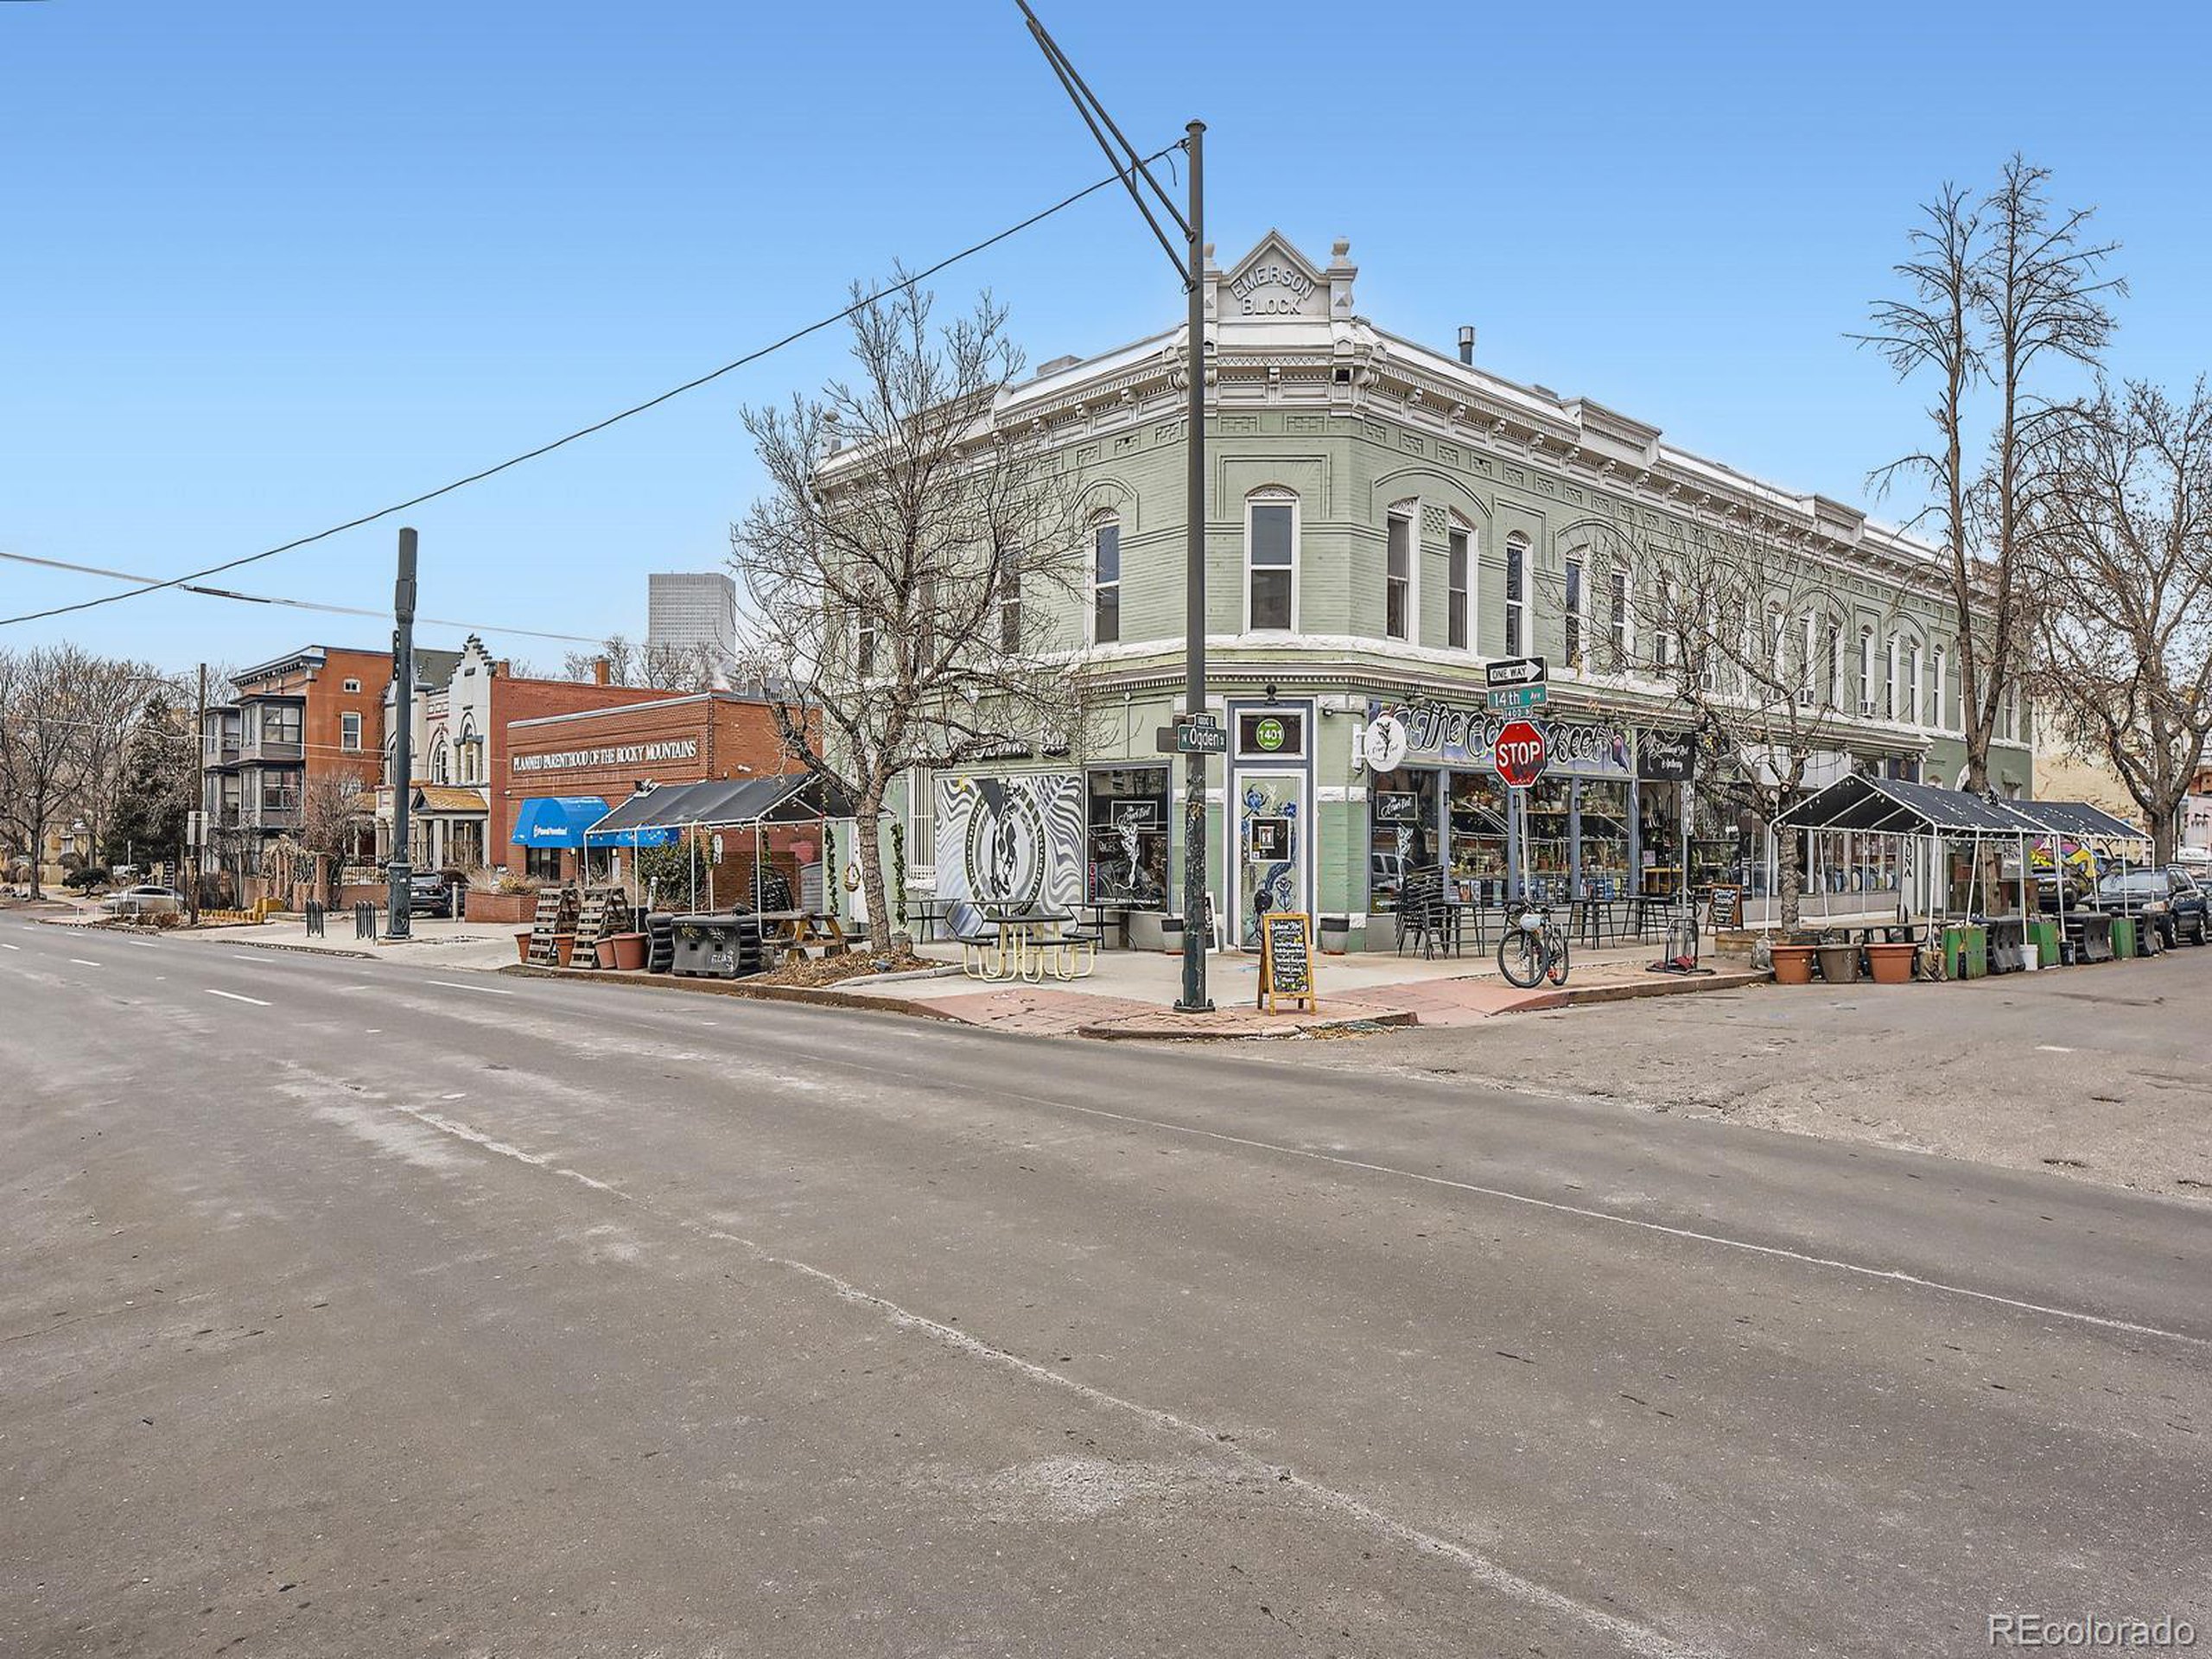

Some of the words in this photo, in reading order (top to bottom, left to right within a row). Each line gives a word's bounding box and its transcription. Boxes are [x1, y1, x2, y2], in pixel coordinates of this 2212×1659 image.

[1229, 265, 1316, 301] EMERSON
[1242, 297, 1301, 315] BLOCK
[1492, 670, 1509, 680] ONE
[1510, 666, 1527, 677] WAY
[1494, 692, 1520, 707] 14th
[1189, 728, 1219, 751] Ogden
[1259, 728, 1282, 741] 1401
[513, 754, 542, 771] PLANNED
[543, 750, 588, 769] PARENTHOOD
[589, 749, 600, 766] OF
[601, 748, 615, 764] THE
[617, 746, 645, 762] ROCKY
[646, 741, 696, 760] MOUNTAINS
[1498, 741, 1541, 768] STOP
